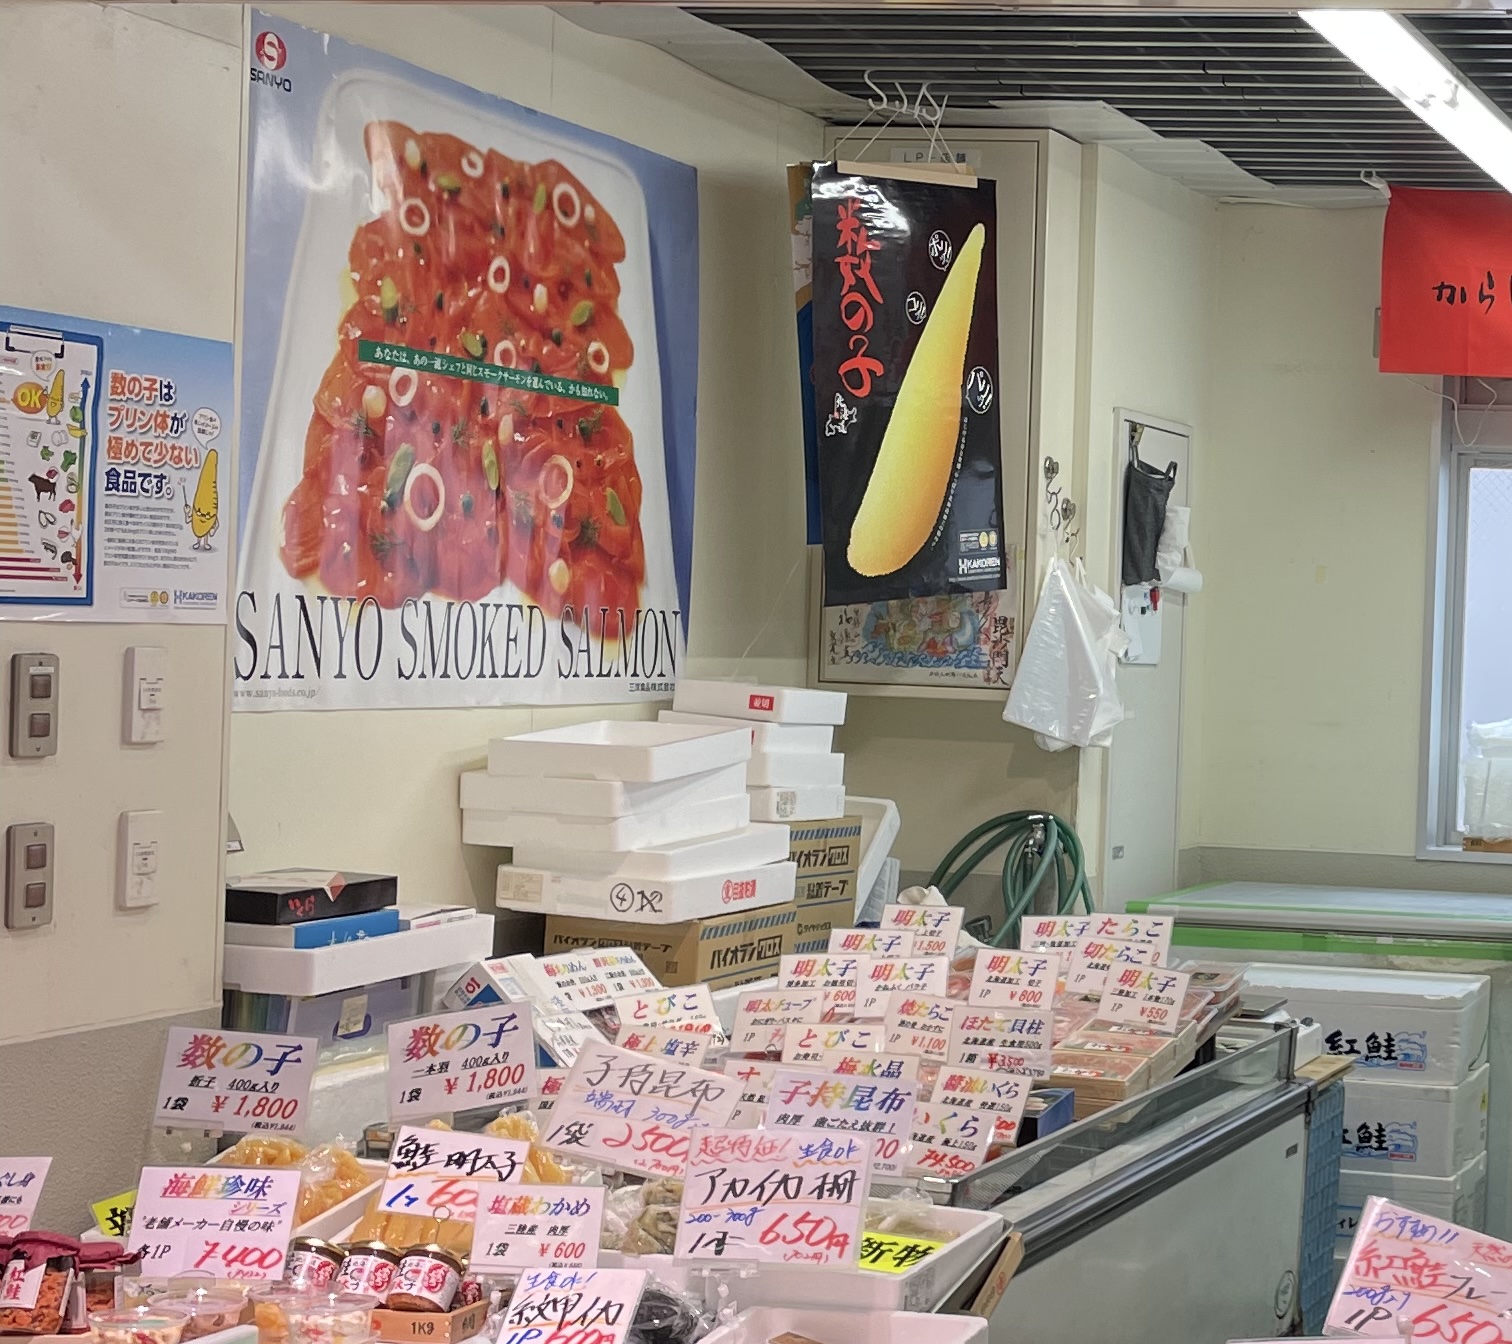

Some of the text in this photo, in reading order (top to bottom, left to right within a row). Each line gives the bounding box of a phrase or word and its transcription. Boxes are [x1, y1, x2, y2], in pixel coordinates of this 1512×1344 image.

[250, 68, 291, 92] SANYO
[109, 370, 174, 402] 数の子は
[18, 391, 41, 408] OK
[108, 406, 188, 434] プリン体が
[107, 436, 200, 466] 極めて少ない
[234, 591, 681, 681] SANYO SMOKED SALMON
[891, 910, 951, 928] 明太子
[1035, 920, 1090, 936] 明太子
[1097, 918, 1164, 937] たらこ
[840, 934, 901, 951] 明太子
[1083, 942, 1148, 964] 切たらこ
[792, 960, 857, 977] 明太子
[871, 963, 934, 981] 明太子
[986, 955, 1046, 975] 明太子
[1074, 974, 1086, 983] 1P
[1117, 969, 1177, 993] 明太子
[864, 998, 876, 1008] 1P
[979, 989, 991, 998] 1P
[632, 992, 698, 1020] とびこ
[898, 999, 952, 1021] 焼たらこ
[1110, 1003, 1123, 1012] 1P
[960, 1016, 1046, 1035] ほたて貝柱
[403, 1013, 518, 1063] 数の子
[743, 1033, 756, 1042] 1P
[799, 1029, 872, 1048] とびこ
[889, 1033, 901, 1043] 1P
[1324, 1029, 1399, 1062] 紅鮭
[177, 1034, 304, 1076] 数の子
[834, 1057, 905, 1079] 梅水晶
[162, 1096, 189, 1111] 1袋
[399, 1087, 422, 1104] 1袋
[780, 1080, 912, 1114] 子持昆布
[161, 1173, 274, 1199] 海鮮珍味
[230, 1203, 287, 1217] シリーズ
[489, 1195, 591, 1216] 塩蔵わかめ
[759, 1211, 850, 1259] 650円
[487, 1243, 509, 1256] 1袋
[860, 1236, 937, 1269] 新物
